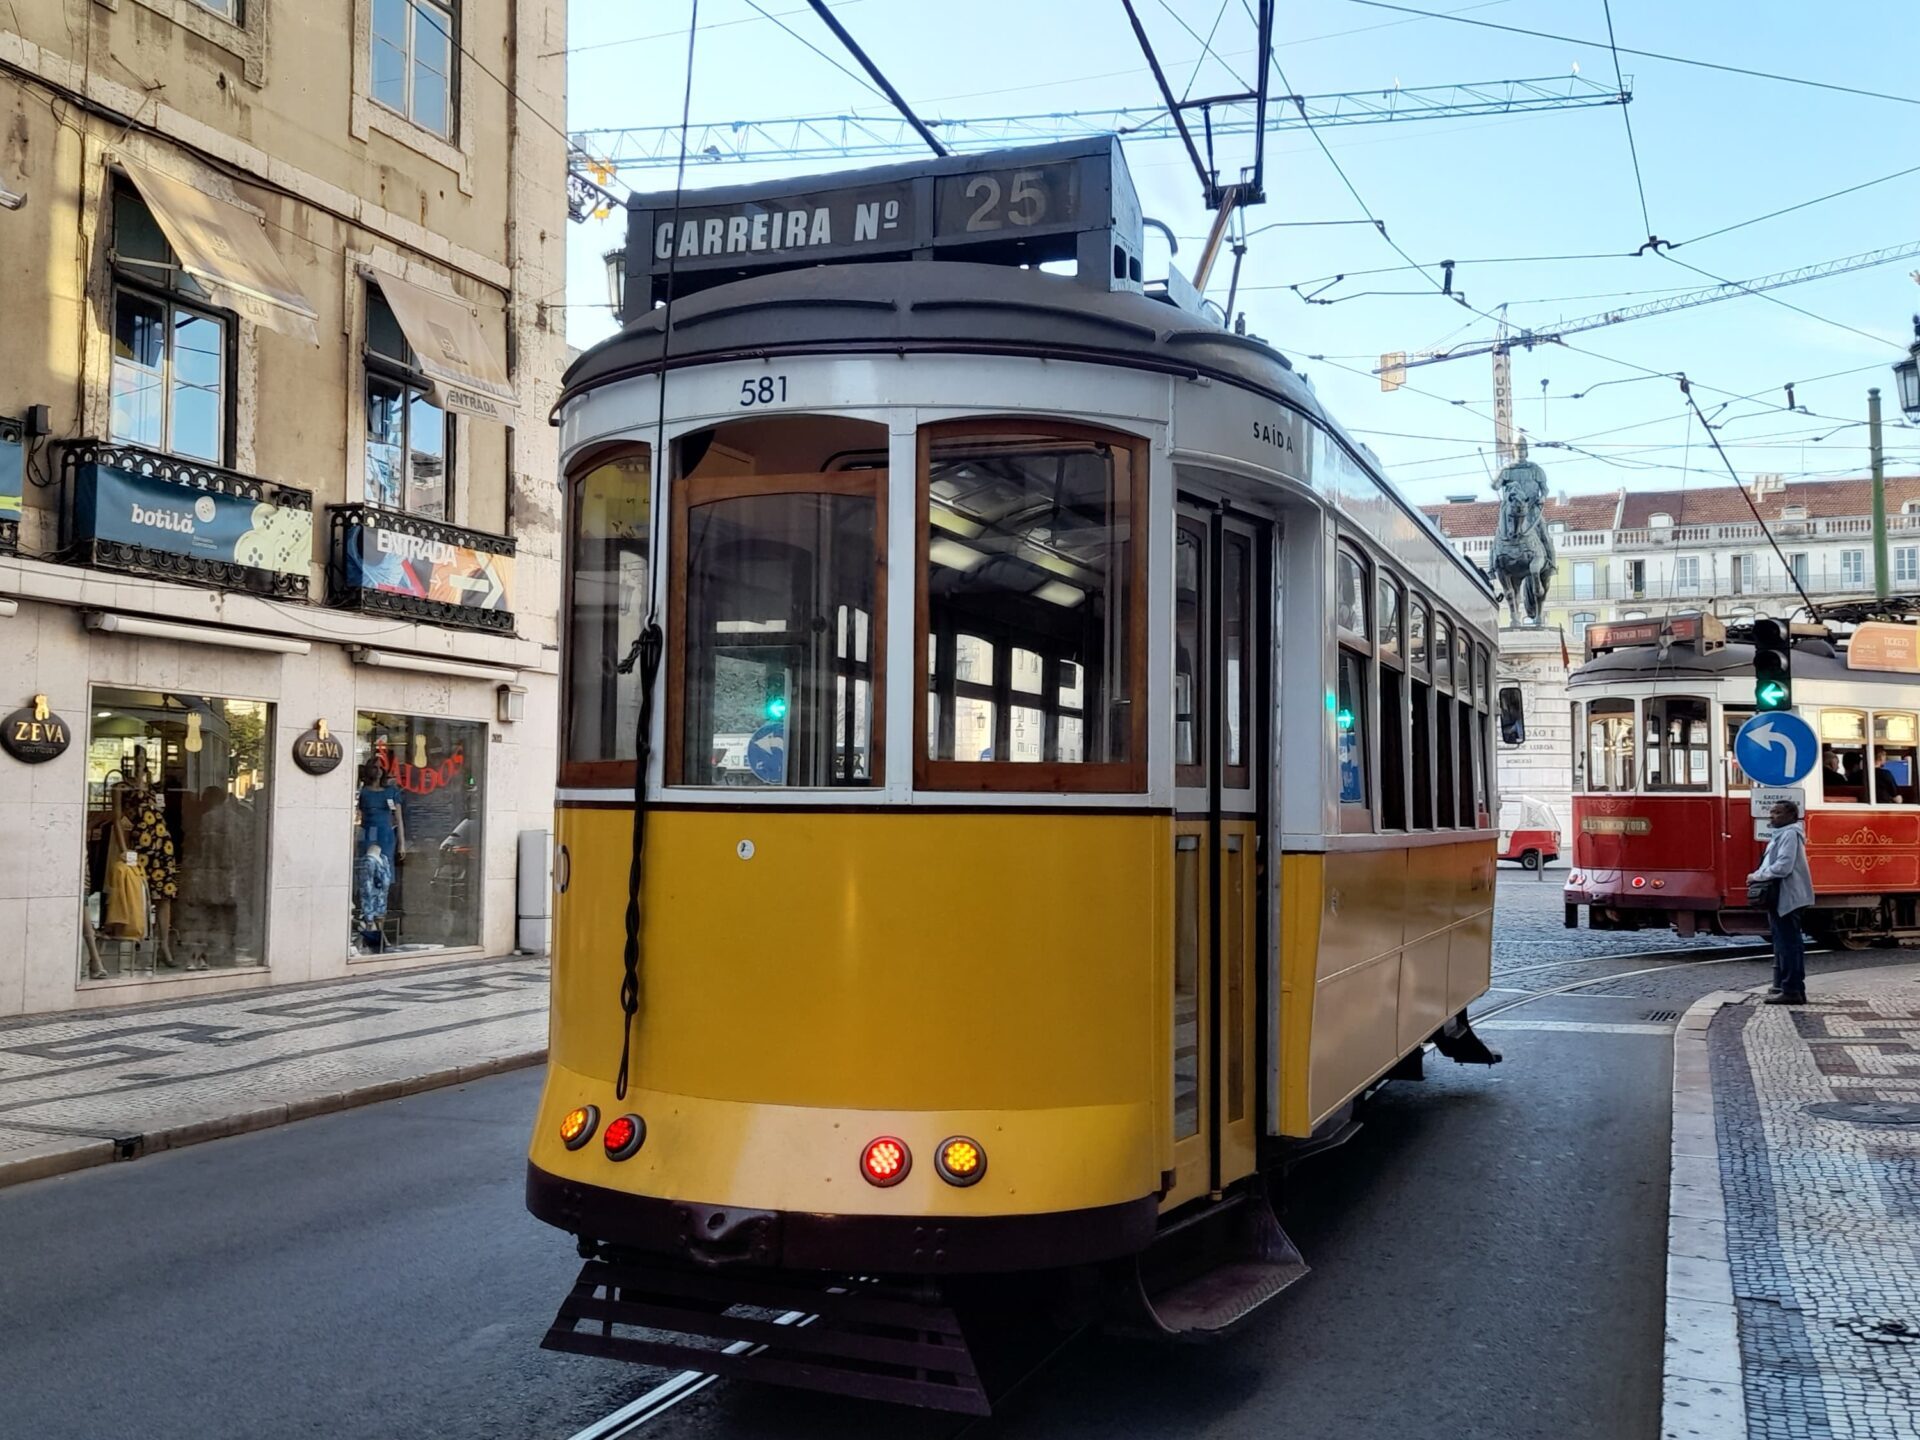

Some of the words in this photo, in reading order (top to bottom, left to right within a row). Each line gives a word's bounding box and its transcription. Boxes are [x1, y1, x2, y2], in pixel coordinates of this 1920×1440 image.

[655, 207, 831, 260] CARREIRA
[966, 170, 1046, 232] 25
[448, 390, 498, 415] ENTRADA
[740, 376, 787, 406] 581
[1253, 421, 1293, 454] SAÍDA
[377, 528, 457, 568] ENTRADA
[15, 721, 65, 743] ZEVA
[305, 741, 340, 759] ZEVA
